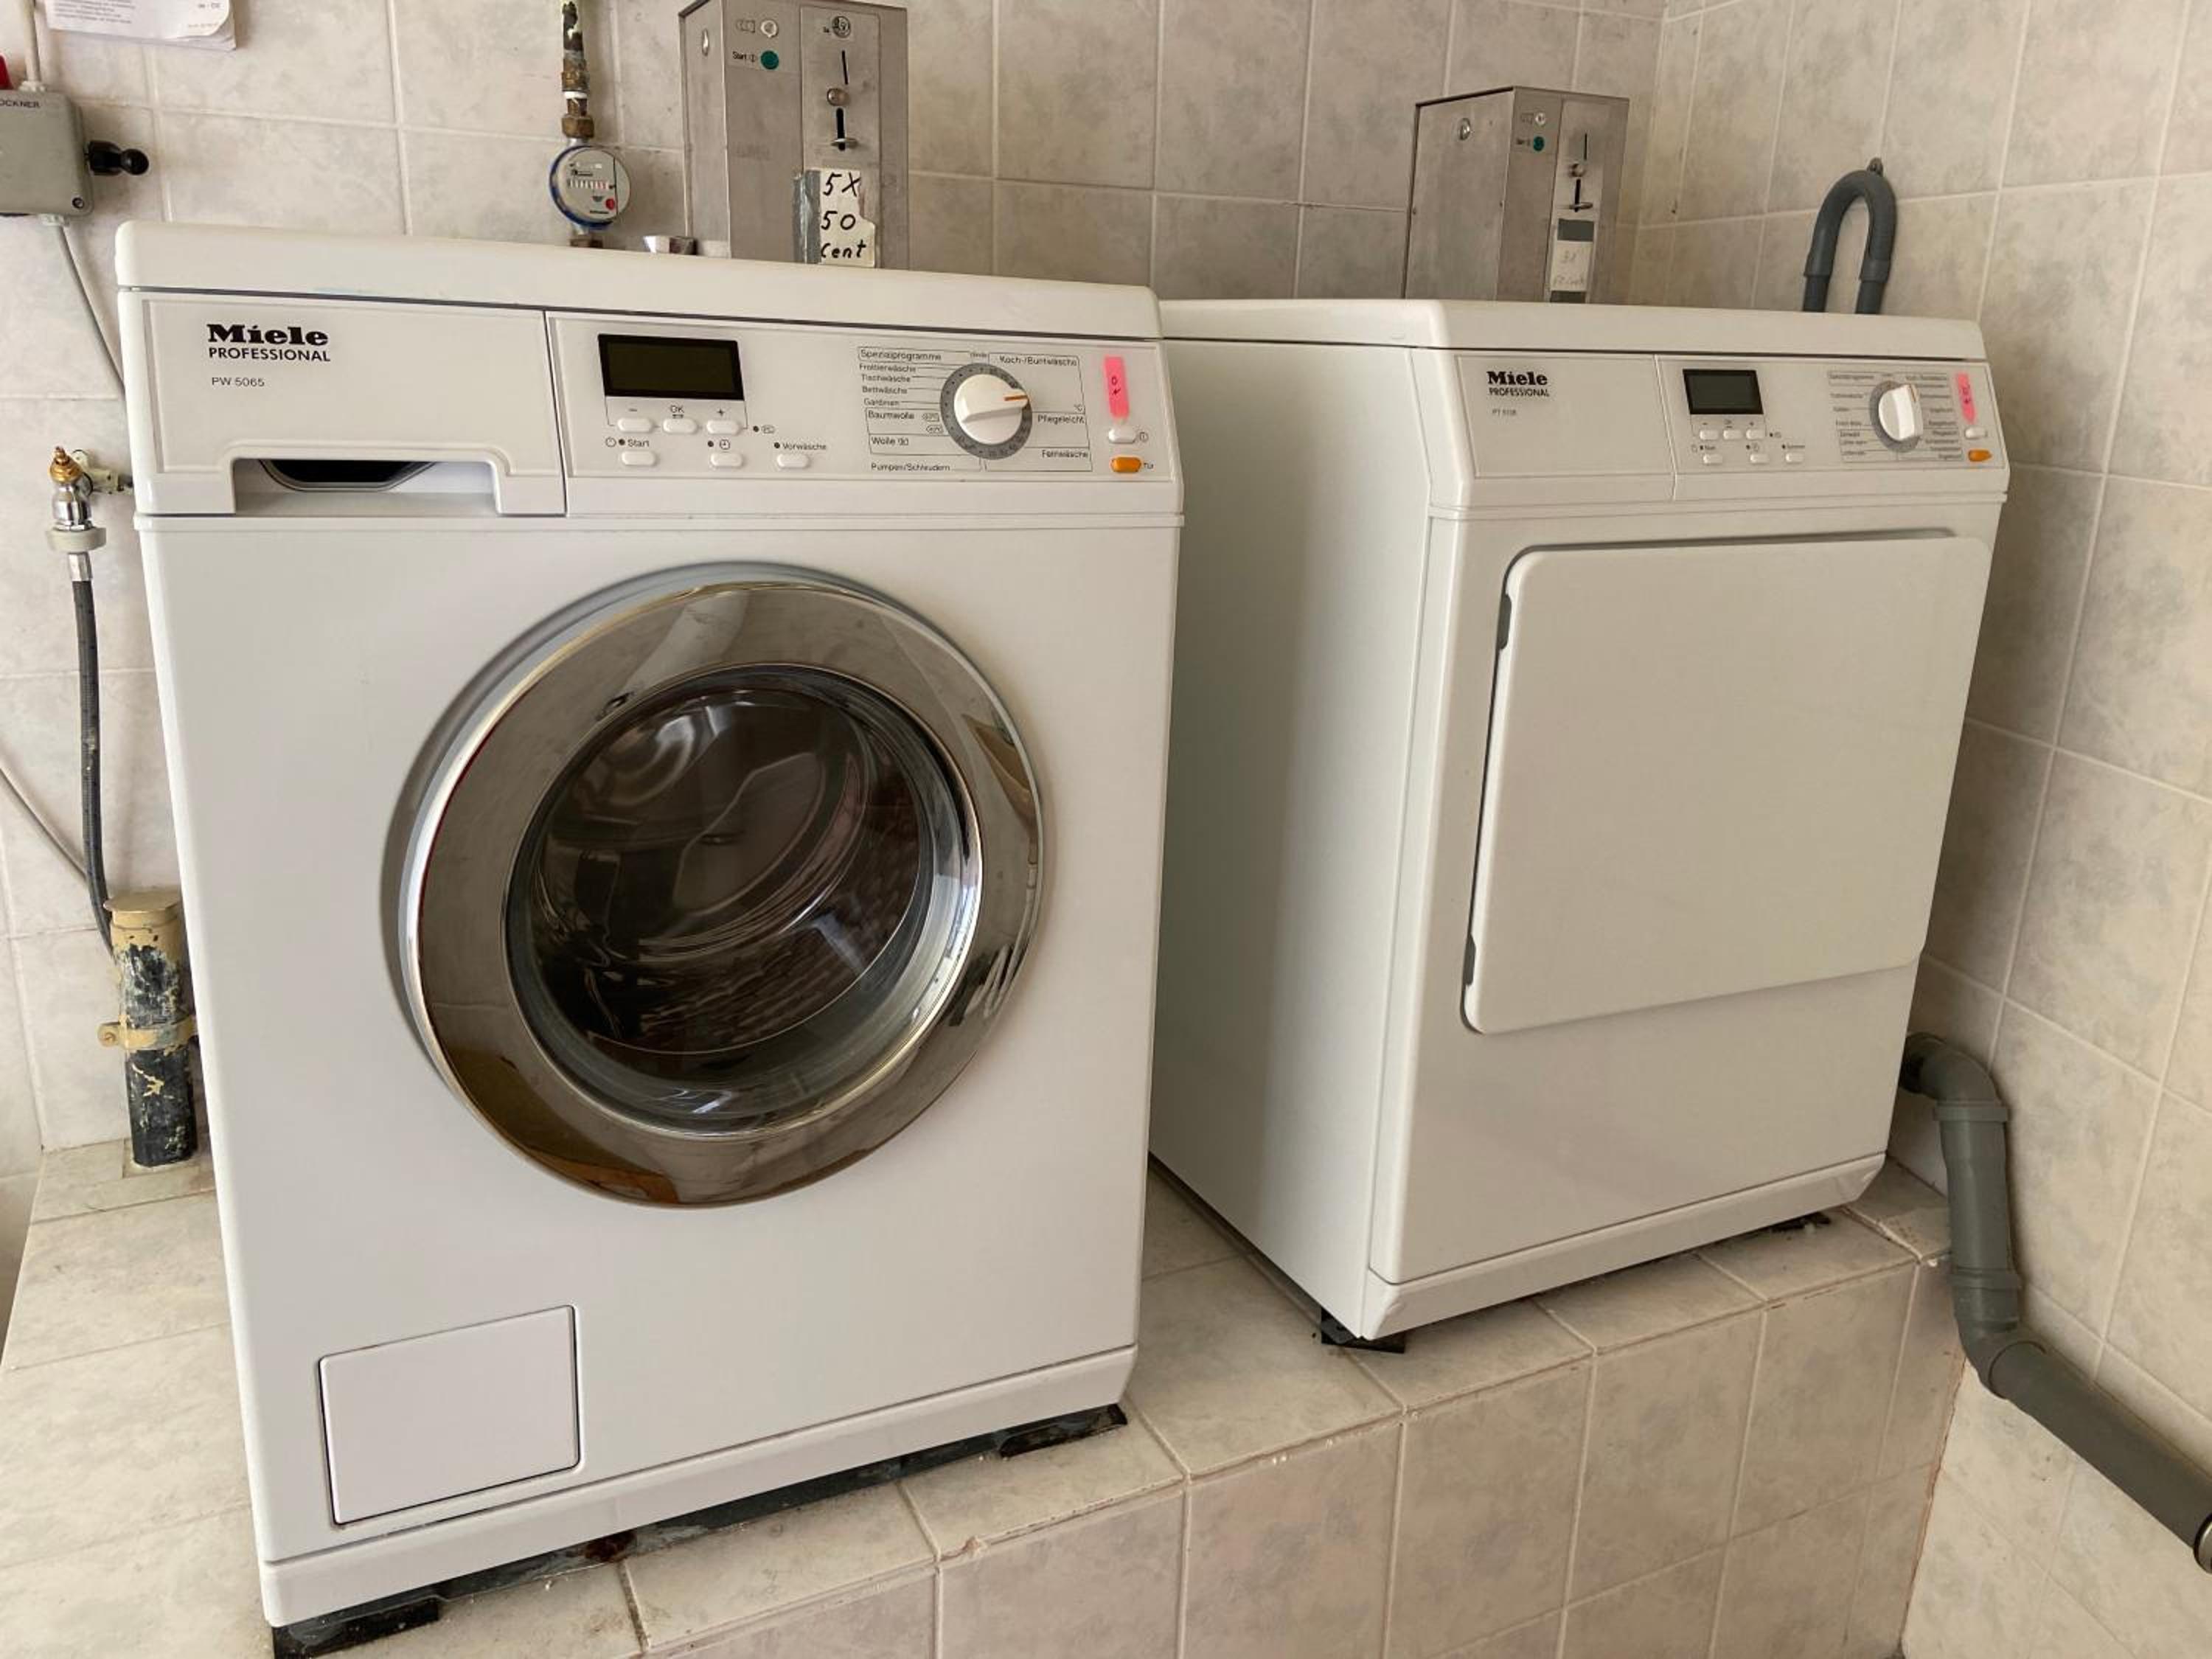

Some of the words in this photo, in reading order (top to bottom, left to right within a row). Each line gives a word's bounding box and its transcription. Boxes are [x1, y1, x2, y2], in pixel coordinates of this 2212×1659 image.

[821, 210, 856, 231] 50
[206, 324, 328, 346] Miele
[208, 347, 331, 362] PROFESSIONAL
[212, 377, 232, 386] PW
[235, 378, 265, 387] 5065
[1486, 371, 1548, 386] Miele
[1489, 387, 1550, 397] PROFESSIONAL
[670, 405, 684, 414] OK
[868, 409, 915, 419] Baumwolle
[627, 439, 650, 448] Start
